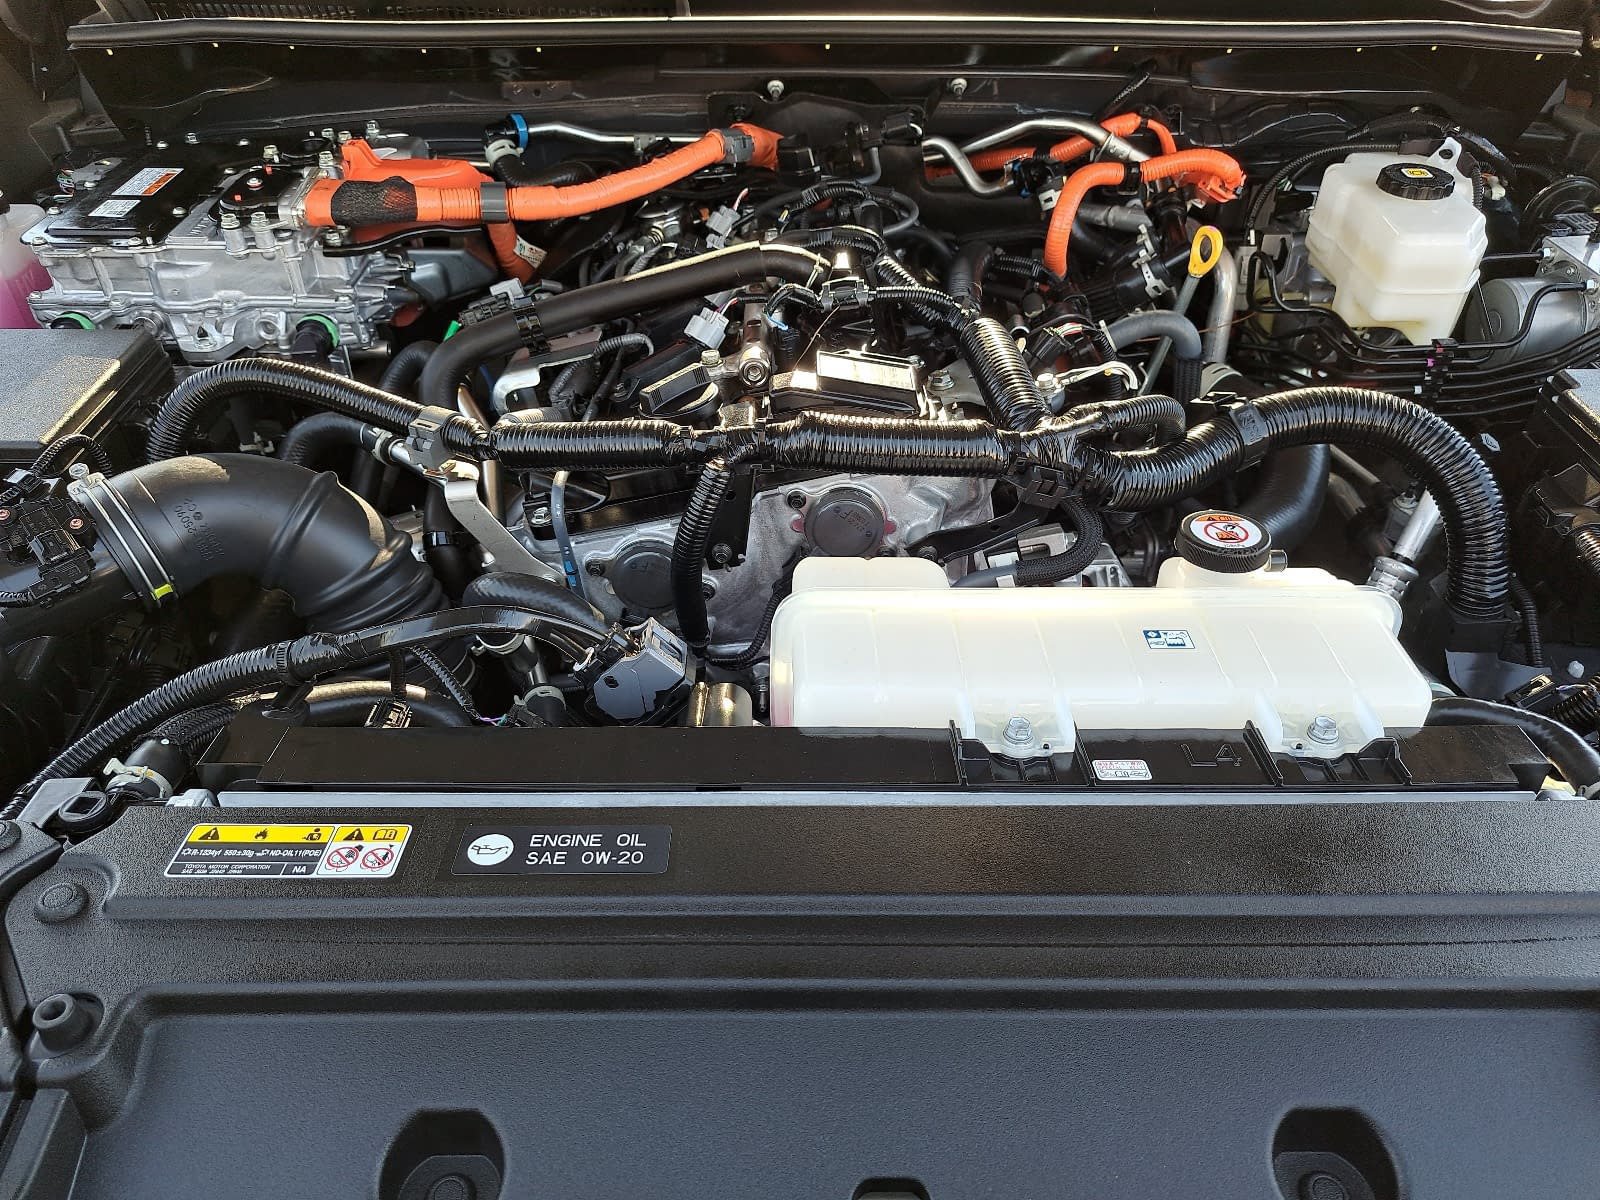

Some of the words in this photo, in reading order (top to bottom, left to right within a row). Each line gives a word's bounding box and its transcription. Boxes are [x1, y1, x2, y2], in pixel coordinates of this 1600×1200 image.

[529, 833, 603, 848] ENGINE
[616, 833, 647, 847] OIL
[525, 851, 568, 866] SAE
[291, 865, 307, 874] NA
